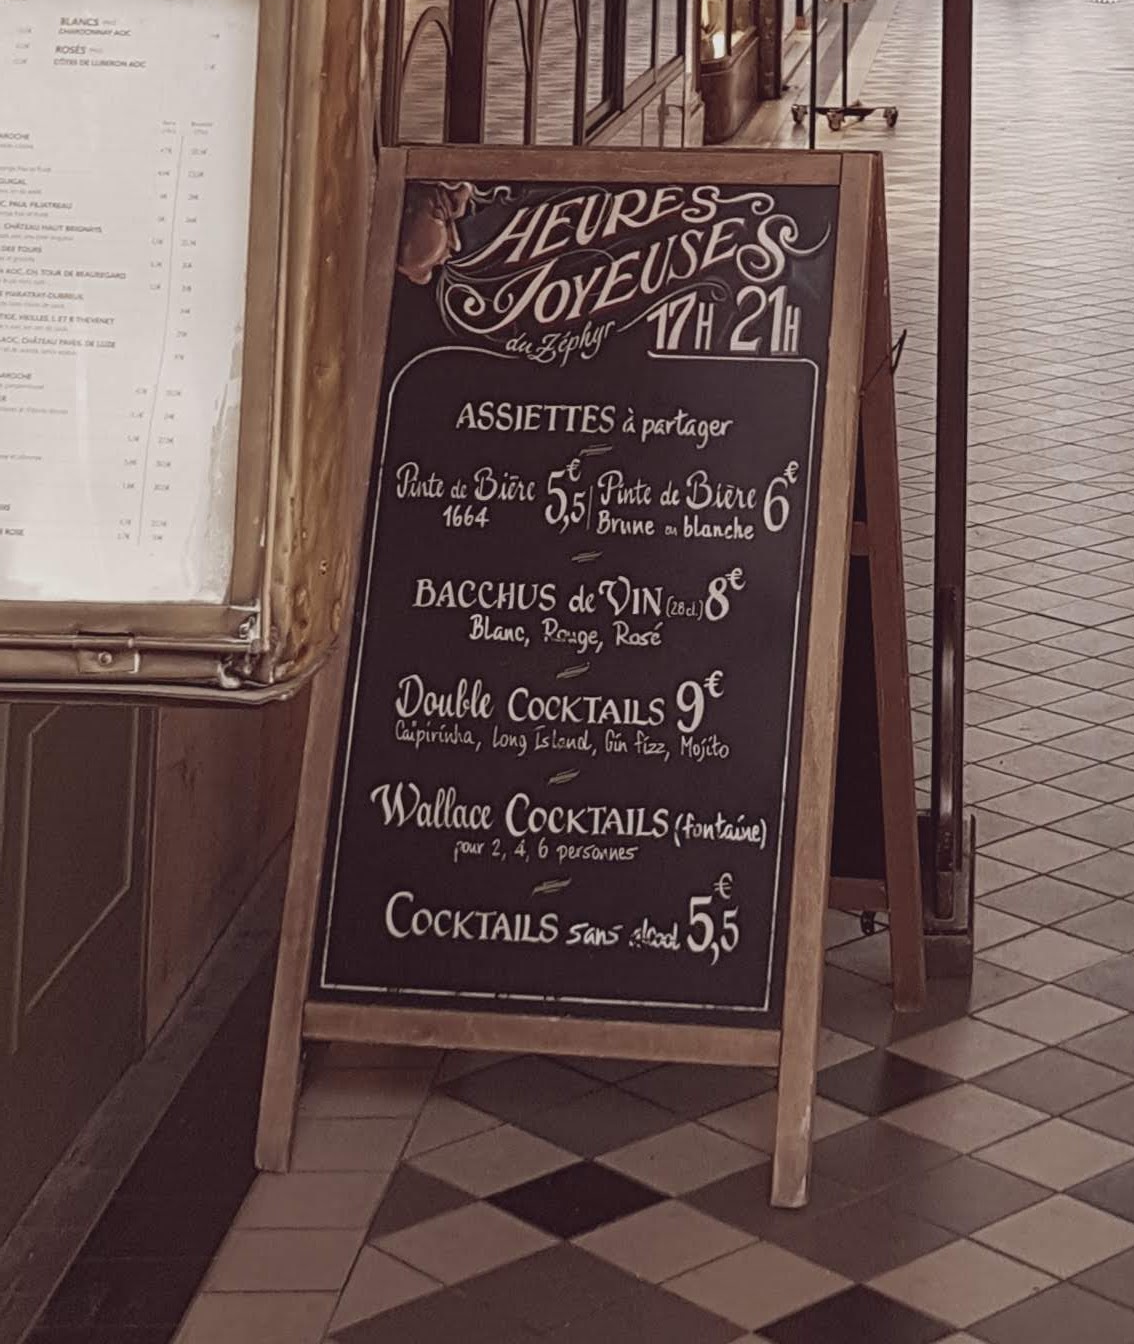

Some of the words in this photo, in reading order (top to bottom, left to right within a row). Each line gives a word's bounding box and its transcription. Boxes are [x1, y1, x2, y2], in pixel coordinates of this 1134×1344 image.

[489, 184, 721, 265] HEURES
[455, 213, 805, 335] JOYEUSES
[647, 291, 714, 353] 17H
[730, 285, 802, 355] 21H
[505, 335, 533, 355] du
[533, 320, 617, 368] Zéphyr
[455, 400, 616, 435] ASSIETTES
[621, 407, 637, 435] à
[639, 408, 734, 450] partager
[396, 461, 446, 501] Pinte
[450, 477, 469, 501] de
[473, 466, 538, 504] Bière
[596, 469, 654, 508] Pinte
[659, 479, 682, 507] de
[685, 469, 758, 511] Bière
[441, 504, 491, 529] 1664
[596, 510, 656, 538] Brune
[682, 512, 756, 542] blanche
[412, 578, 557, 612] BACCHUS
[568, 587, 597, 614] de
[598, 575, 666, 616] VIN
[468, 613, 531, 648] Blanc,
[541, 617, 605, 655] Rouge,
[614, 621, 664, 648] Rosé
[395, 673, 495, 720] Double
[507, 686, 666, 728] COCKTAILS
[491, 725, 528, 758] Long
[604, 732, 629, 755] Gin
[680, 734, 730, 763] Mojito
[370, 782, 495, 832] Wallace
[504, 792, 671, 839] COCKTAILS
[673, 812, 769, 851] (fontaine)
[452, 838, 485, 863] pour
[537, 838, 550, 859] 6
[555, 844, 640, 864] personnes
[384, 890, 560, 943] COCKTAILS
[564, 923, 626, 948] sans
[628, 918, 683, 951] alcool
